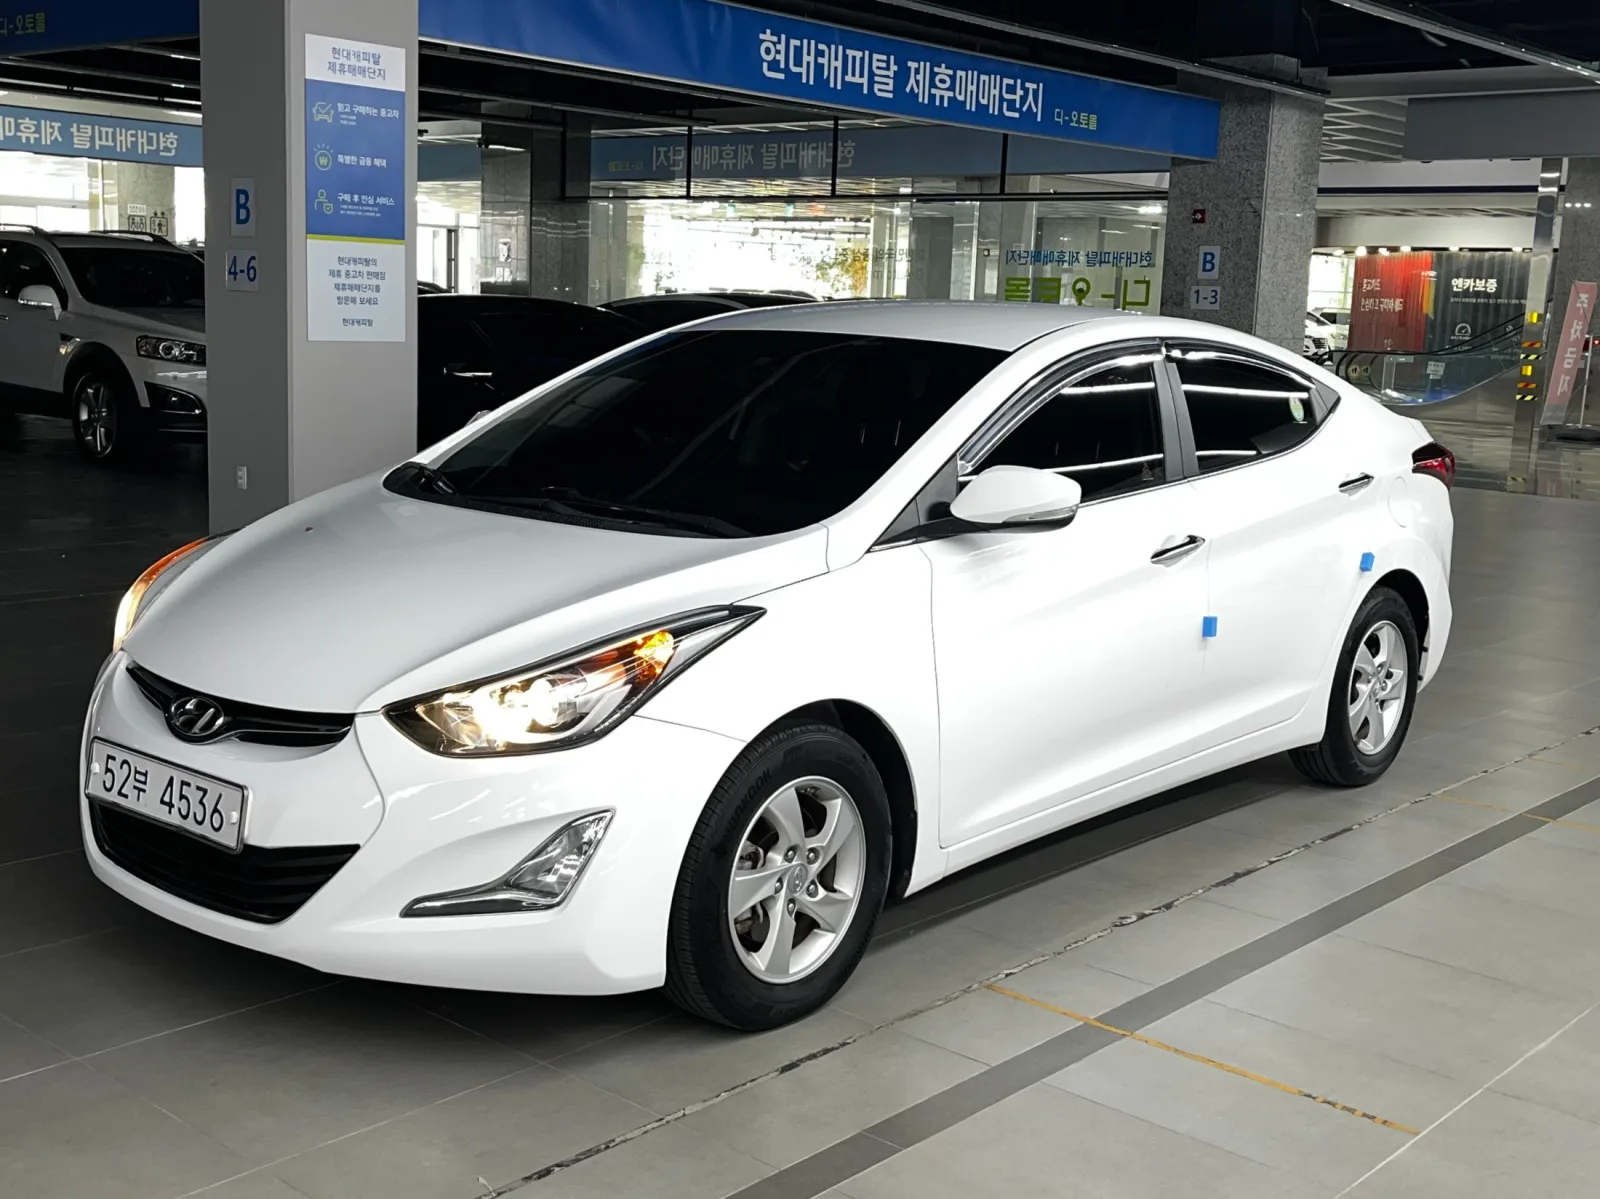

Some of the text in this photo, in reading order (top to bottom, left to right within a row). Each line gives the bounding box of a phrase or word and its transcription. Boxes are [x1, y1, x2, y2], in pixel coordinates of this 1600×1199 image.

[331, 46, 381, 66] 현대캐피탈
[327, 61, 386, 80] 제휴매매단지
[759, 28, 898, 99] 현대캐피탈
[905, 61, 1043, 122] 제휴매매단지
[380, 107, 400, 120] 중고차
[236, 189, 251, 225] B
[375, 196, 396, 206] 서비스
[228, 255, 257, 283] 4-6
[337, 255, 378, 267] 현대캐피탈의
[1202, 251, 1216, 273] B
[344, 269, 365, 280] 중고차
[366, 271, 386, 281] 판매점
[1451, 277, 1498, 293] 엔카보증
[359, 296, 379, 306] 보세요
[1193, 289, 1219, 305] 1-3
[342, 317, 374, 327] 현대캐피탈
[102, 753, 225, 833] 52부 4536
